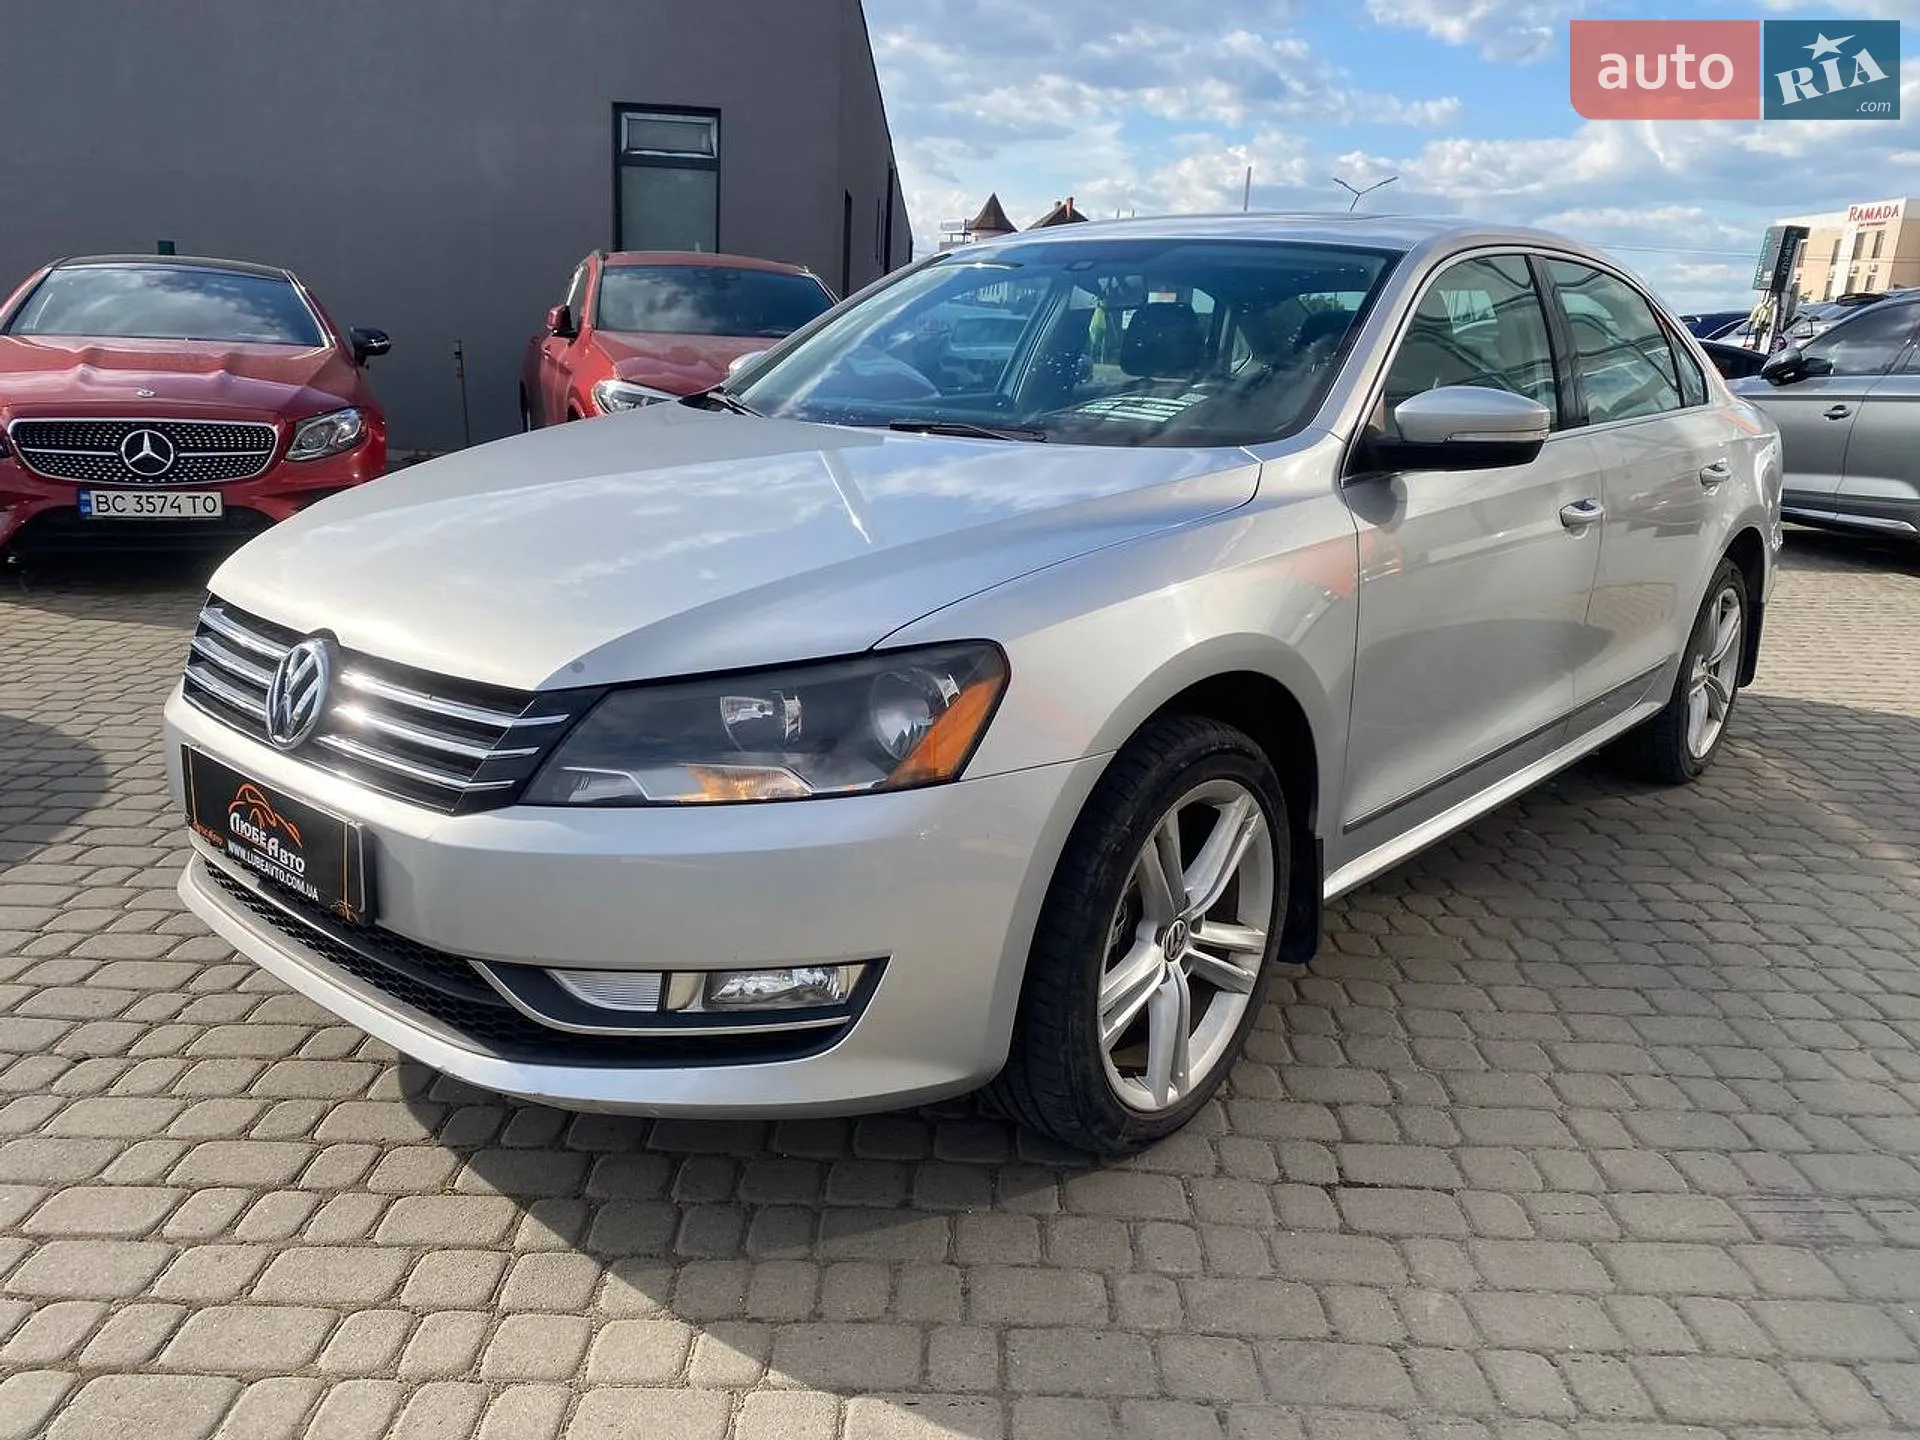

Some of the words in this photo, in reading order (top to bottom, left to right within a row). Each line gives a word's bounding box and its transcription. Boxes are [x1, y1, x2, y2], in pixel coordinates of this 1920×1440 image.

[1849, 204, 1899, 222] RAMADA
[95, 494, 126, 513] BC
[133, 494, 182, 514] 3574
[187, 495, 217, 514] TO
